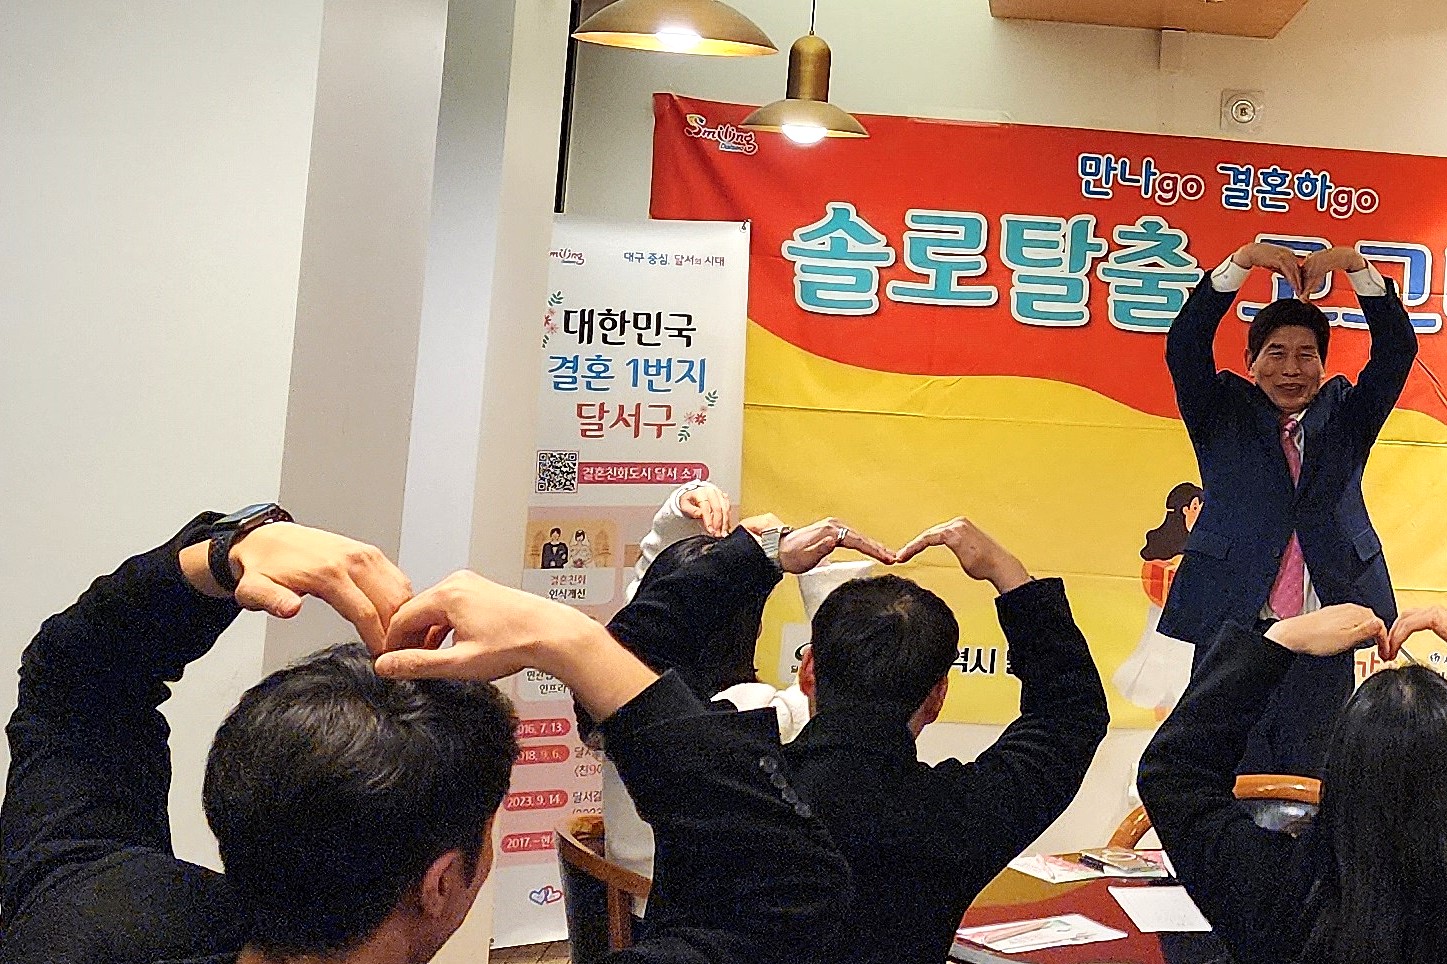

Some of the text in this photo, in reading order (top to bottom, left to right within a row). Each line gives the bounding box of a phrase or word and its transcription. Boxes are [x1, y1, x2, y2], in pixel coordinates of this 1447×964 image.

[685, 114, 758, 155] Smiling
[1078, 153, 1379, 218] 만나go 결혼하go
[549, 248, 585, 266] miling
[623, 252, 645, 264] 대구
[674, 254, 701, 266] 달서의
[704, 256, 725, 267] 시대
[784, 201, 1205, 334] 솔로탈출
[563, 308, 697, 348] 대한민국
[548, 355, 707, 394] 결혼 1번지
[576, 402, 678, 440] 달서구
[582, 466, 652, 481] 결혼친화도시
[654, 467, 678, 480] 달서
[507, 795, 534, 808] 2023.
